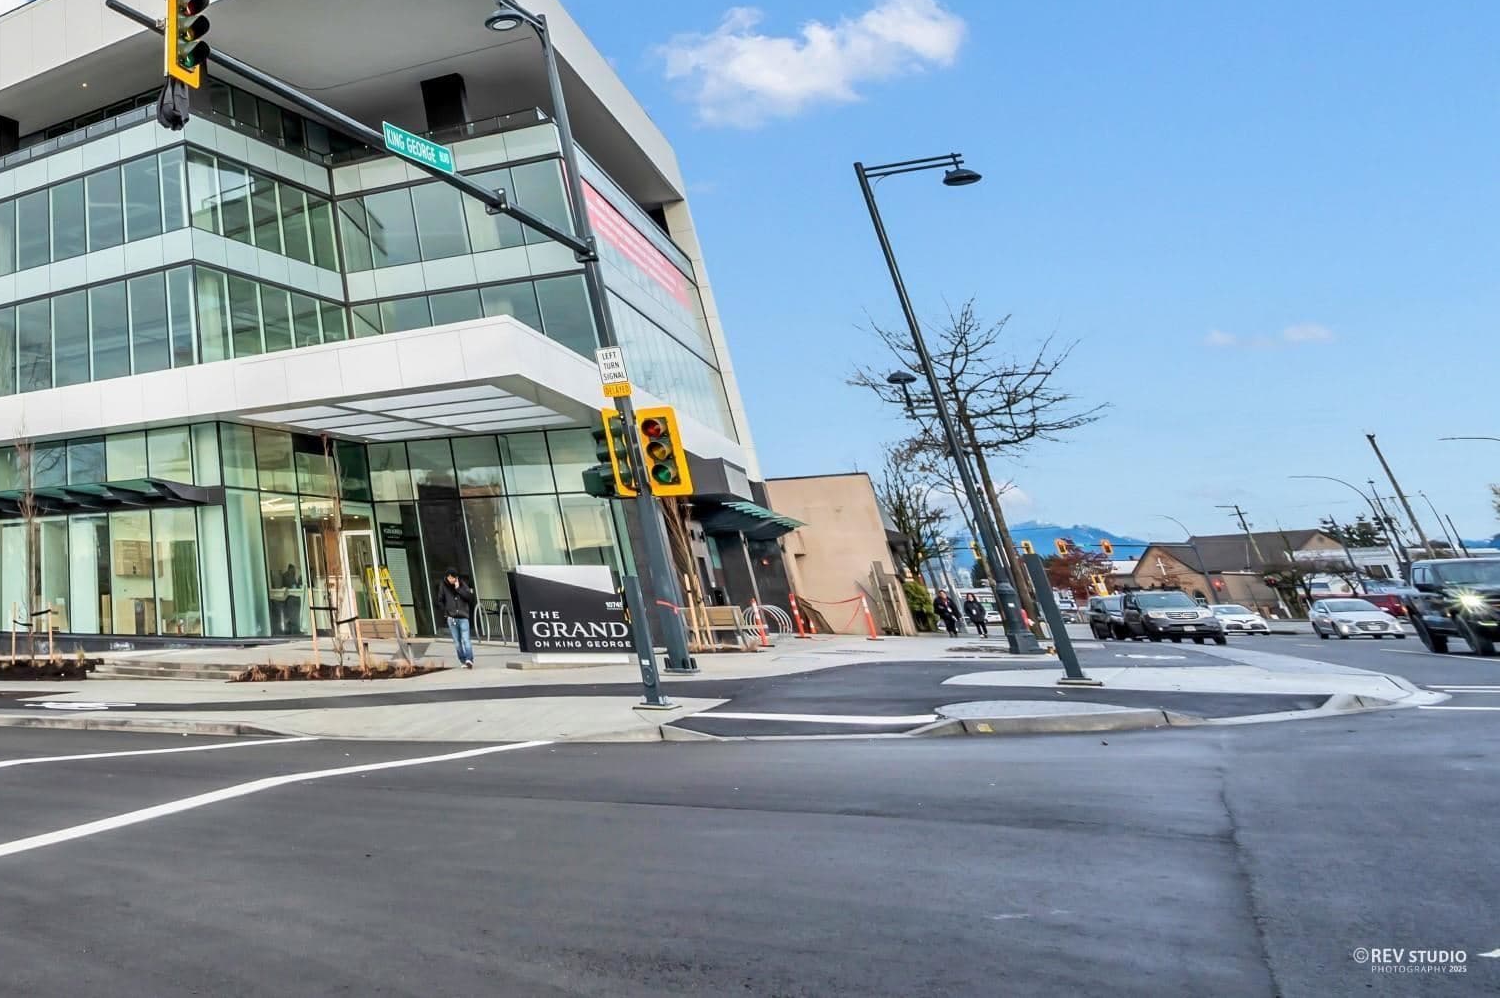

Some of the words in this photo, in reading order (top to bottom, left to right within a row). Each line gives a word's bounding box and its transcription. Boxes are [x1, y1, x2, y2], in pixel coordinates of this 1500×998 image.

[386, 128, 405, 151] KING
[406, 137, 437, 163] GEORGE
[602, 351, 617, 361] LEFT
[604, 361, 620, 370] TURN
[603, 371, 626, 381] SIGNAL
[604, 384, 630, 396] DELAYED
[530, 610, 561, 619] THE
[532, 621, 629, 638] GRAND
[534, 640, 551, 648] ON
[555, 640, 582, 648] KING
[586, 640, 632, 648] GEORGE
